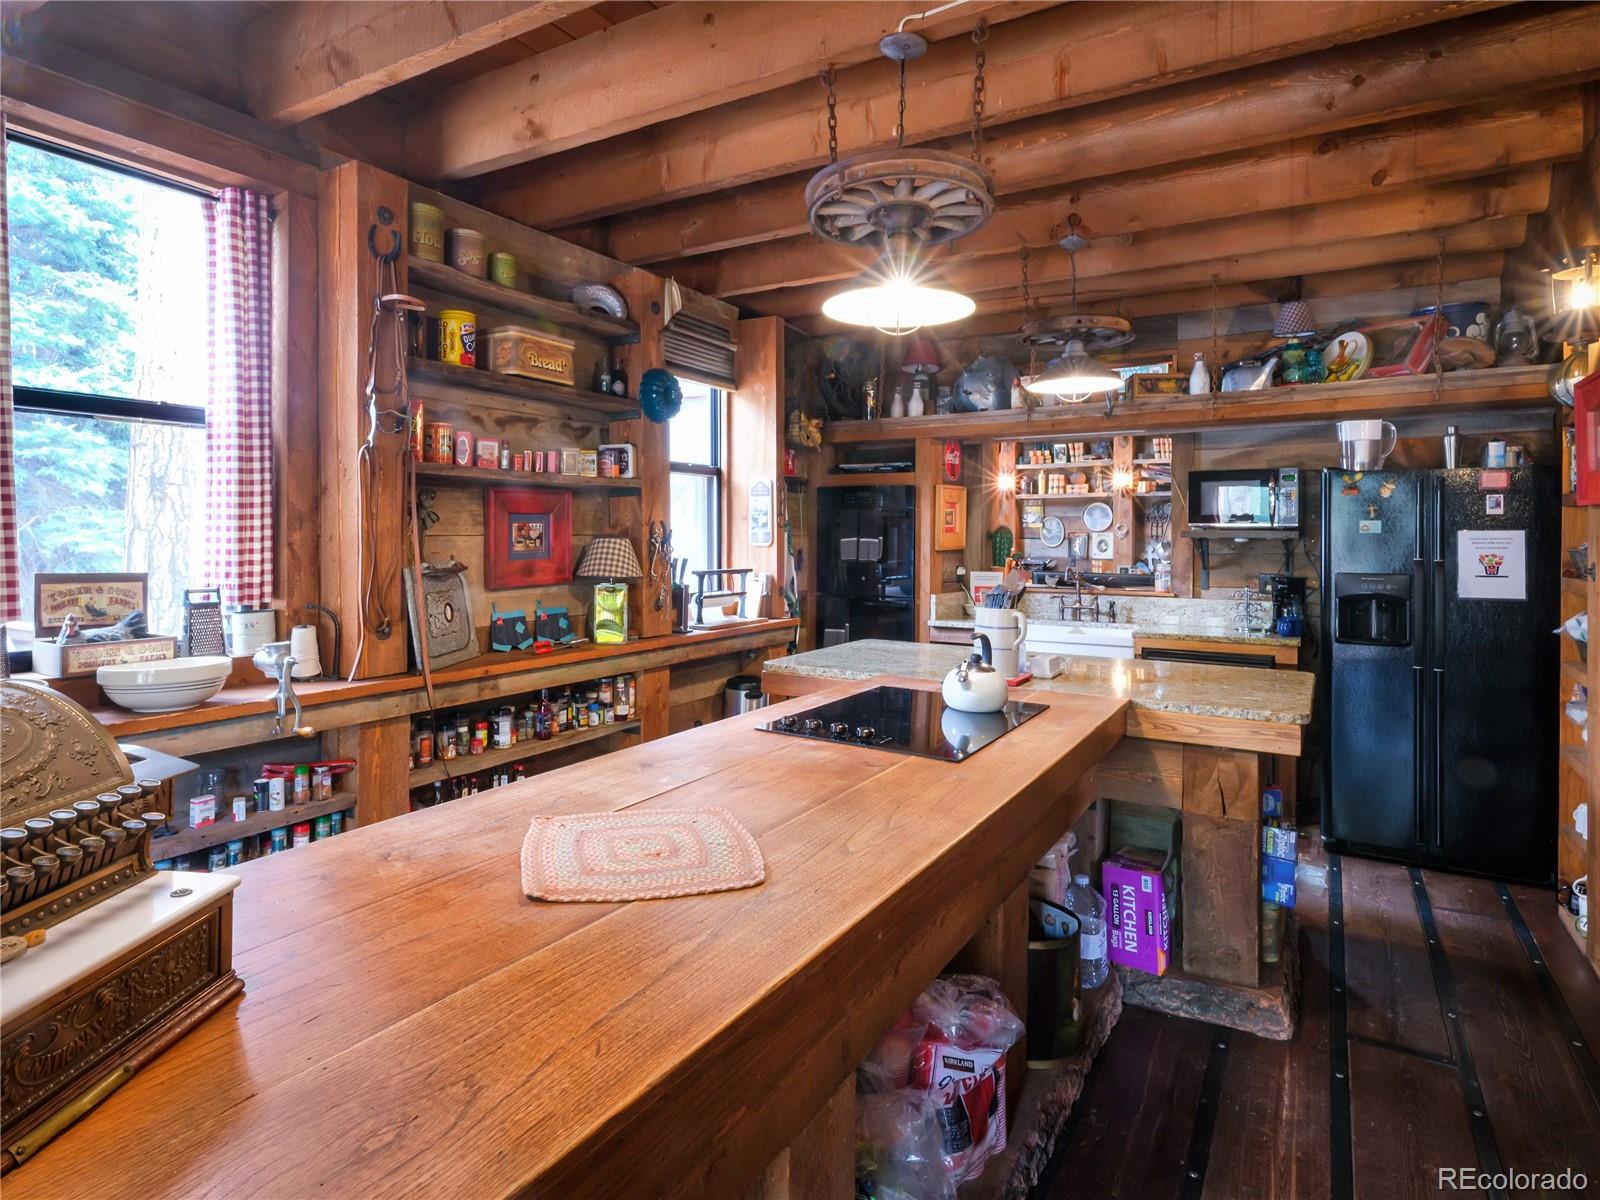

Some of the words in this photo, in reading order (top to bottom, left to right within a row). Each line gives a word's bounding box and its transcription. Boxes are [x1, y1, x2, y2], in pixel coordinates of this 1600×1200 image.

[528, 351, 565, 372] Bread
[1112, 889, 1118, 897] 13
[1122, 885, 1137, 952] KITCHEN
[1111, 929, 1119, 948] Bags
[944, 1057, 974, 1069] KIRKLAND
